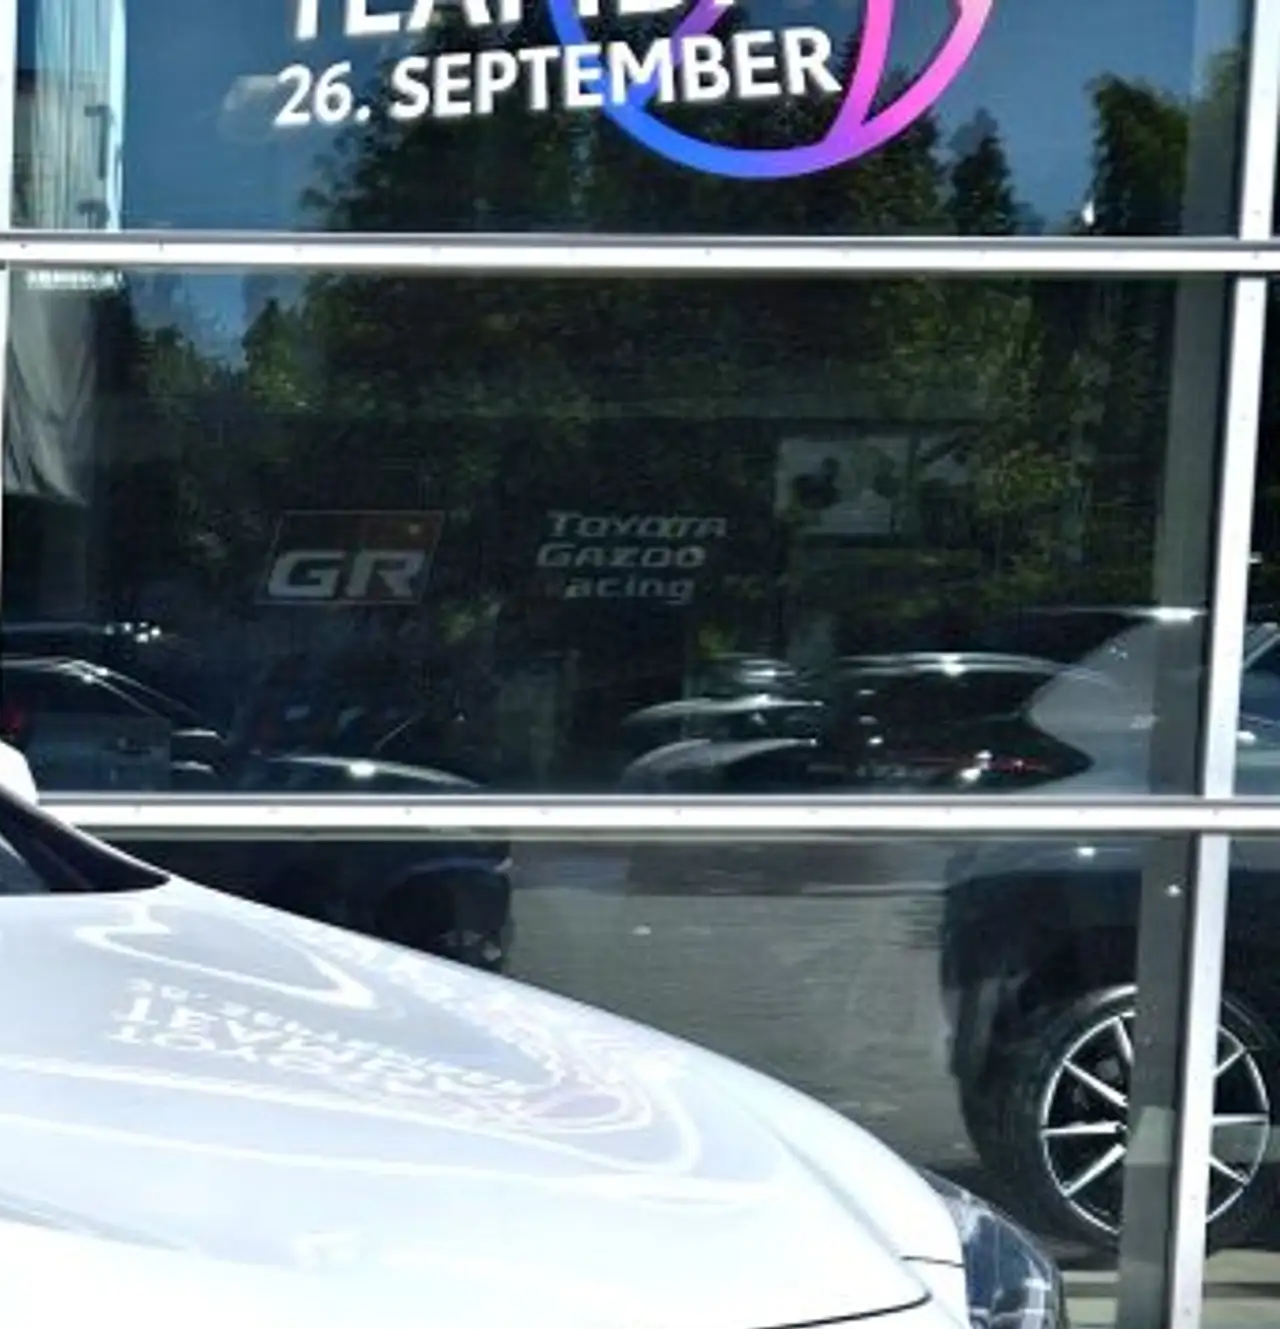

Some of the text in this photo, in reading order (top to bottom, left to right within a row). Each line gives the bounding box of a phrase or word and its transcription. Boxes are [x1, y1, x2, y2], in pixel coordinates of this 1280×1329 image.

[274, 25, 843, 126] 26. SEPTEMBER
[266, 548, 426, 599] GR
[536, 543, 707, 568] GAZOO
[563, 574, 698, 607] acing
